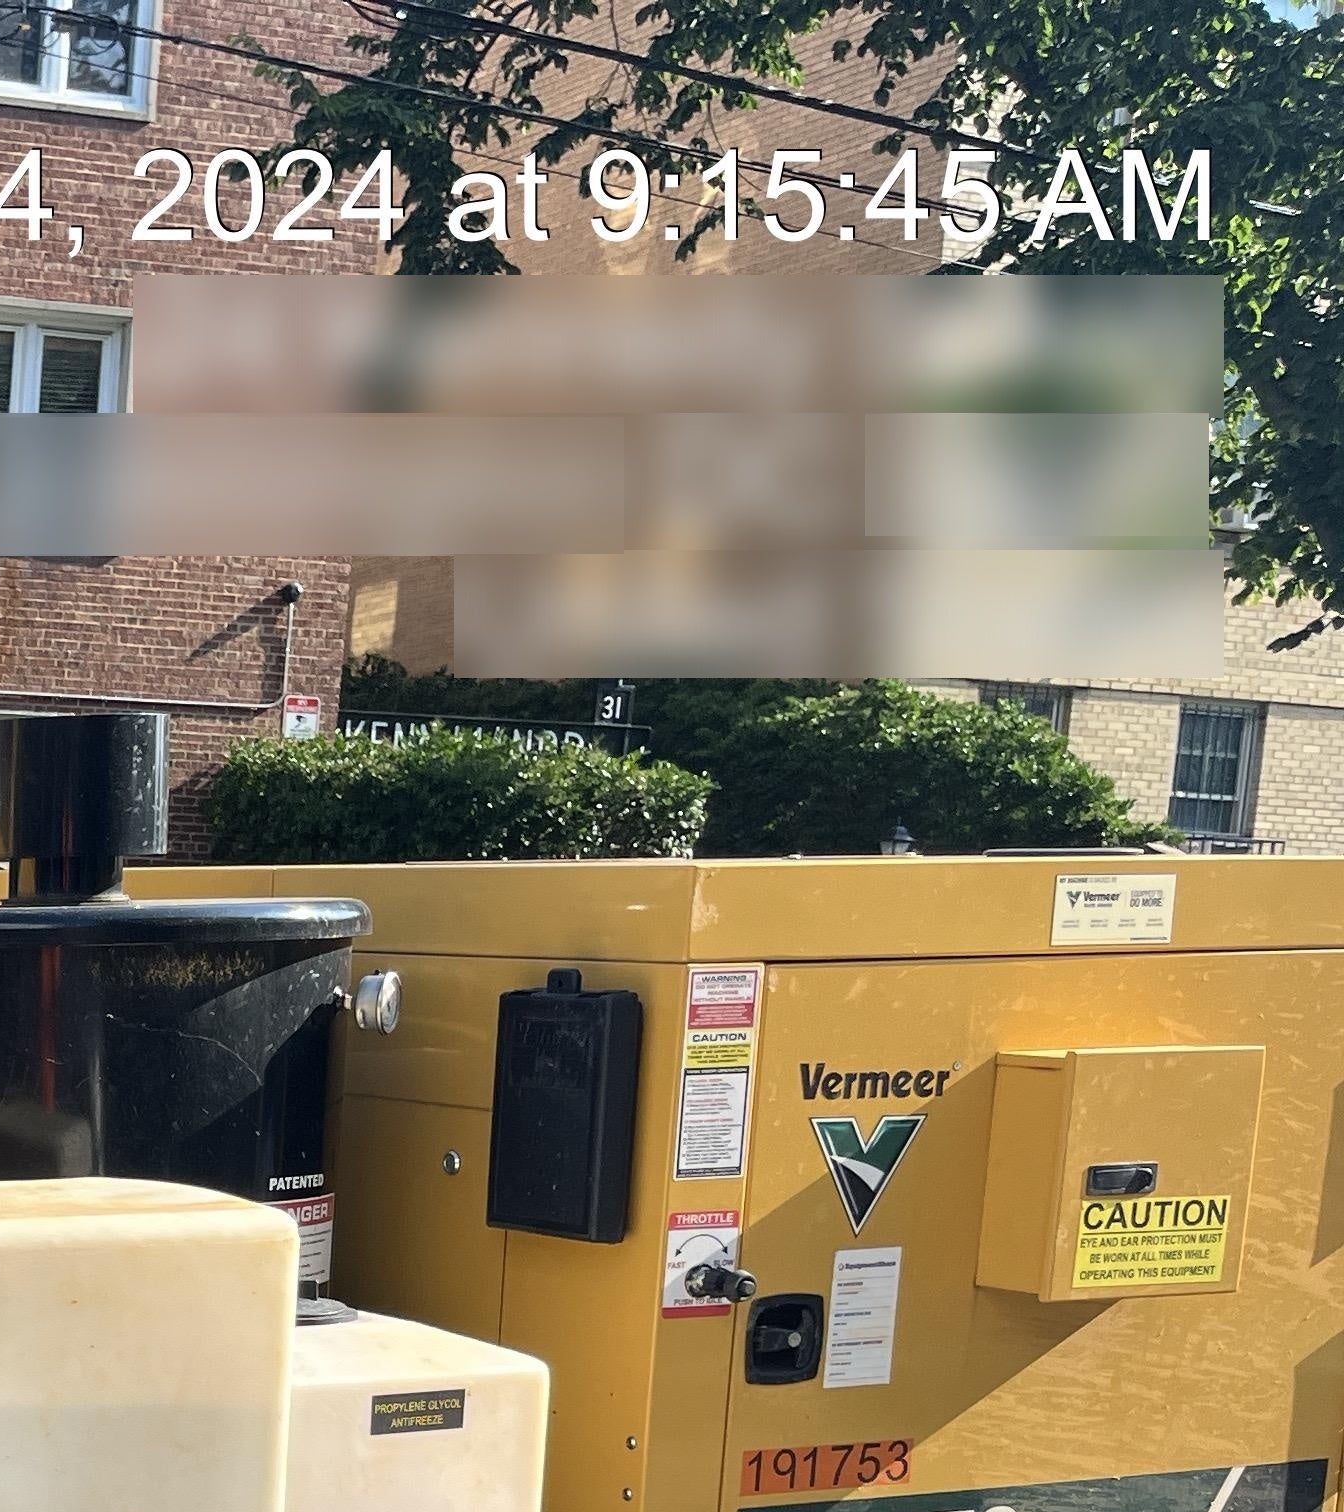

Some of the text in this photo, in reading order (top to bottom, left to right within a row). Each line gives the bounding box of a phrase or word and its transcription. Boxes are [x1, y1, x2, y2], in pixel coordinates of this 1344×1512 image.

[601, 696, 622, 719] 31
[701, 974, 748, 983] WARNING
[692, 1032, 747, 1042] CAUTION
[799, 1061, 951, 1101] Vermeer
[268, 1173, 325, 1192] PATENTED
[675, 1212, 735, 1225] THROTTLE
[1083, 1198, 1228, 1230] CAUTION
[1080, 1233, 1223, 1249] EYE AND EAR PROTECTION MUST
[1089, 1253, 1101, 1264] BE
[1103, 1252, 1129, 1263] WORN
[1142, 1251, 1157, 1262] ALL
[1158, 1250, 1183, 1261] TIMES
[1184, 1249, 1210, 1260] WHILE
[667, 1261, 687, 1270] FAST
[1079, 1265, 1216, 1281] OPERATING THIS EQUIPMENT
[374, 1398, 462, 1415] PROPYLENE GLYCOL
[390, 1413, 444, 1428] ANTIFREEZE
[747, 1440, 910, 1492] 191753
